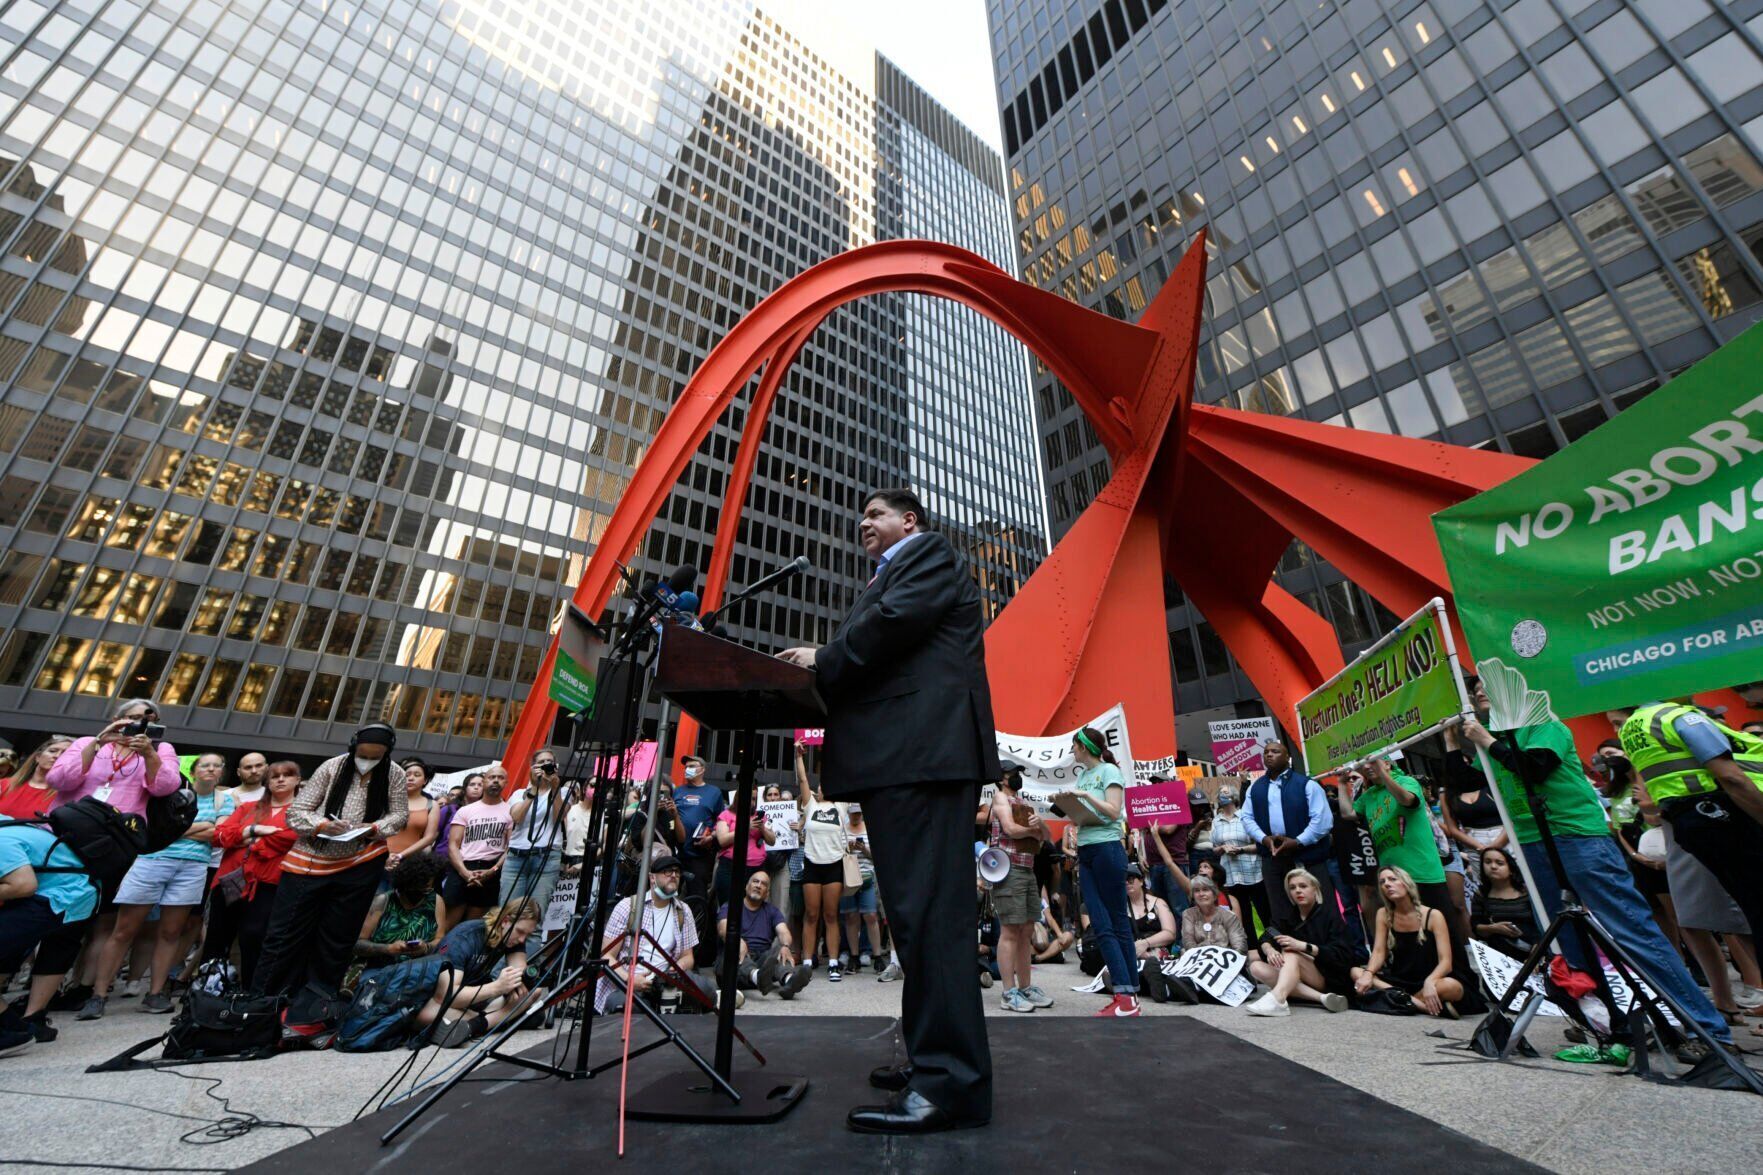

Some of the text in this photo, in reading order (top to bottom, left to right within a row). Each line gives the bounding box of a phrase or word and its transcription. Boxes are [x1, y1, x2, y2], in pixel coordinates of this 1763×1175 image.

[1496, 502, 1574, 555] NO
[666, 592, 679, 604] 5
[1586, 600, 1635, 629] NOT
[1585, 641, 1676, 675] CHICAGO
[1683, 629, 1728, 652] FOR
[1301, 627, 1439, 740] Overturn Roe? HELL NO!
[1213, 722, 1230, 732] LOVE
[1231, 719, 1271, 731] SOMEONE
[1213, 730, 1260, 741] WHO HAD AN
[1217, 740, 1248, 762] BANS OFF
[1223, 749, 1253, 770] MY BODY
[760, 802, 795, 811] SOMEONE
[1131, 795, 1168, 806] Abortion is
[1132, 802, 1181, 814] Health Care.
[486, 839, 502, 847] YOU
[1357, 827, 1377, 867] BODY
[1350, 853, 1365, 876] MY
[555, 883, 573, 892] HAD
[1605, 974, 1630, 1008] NOW
